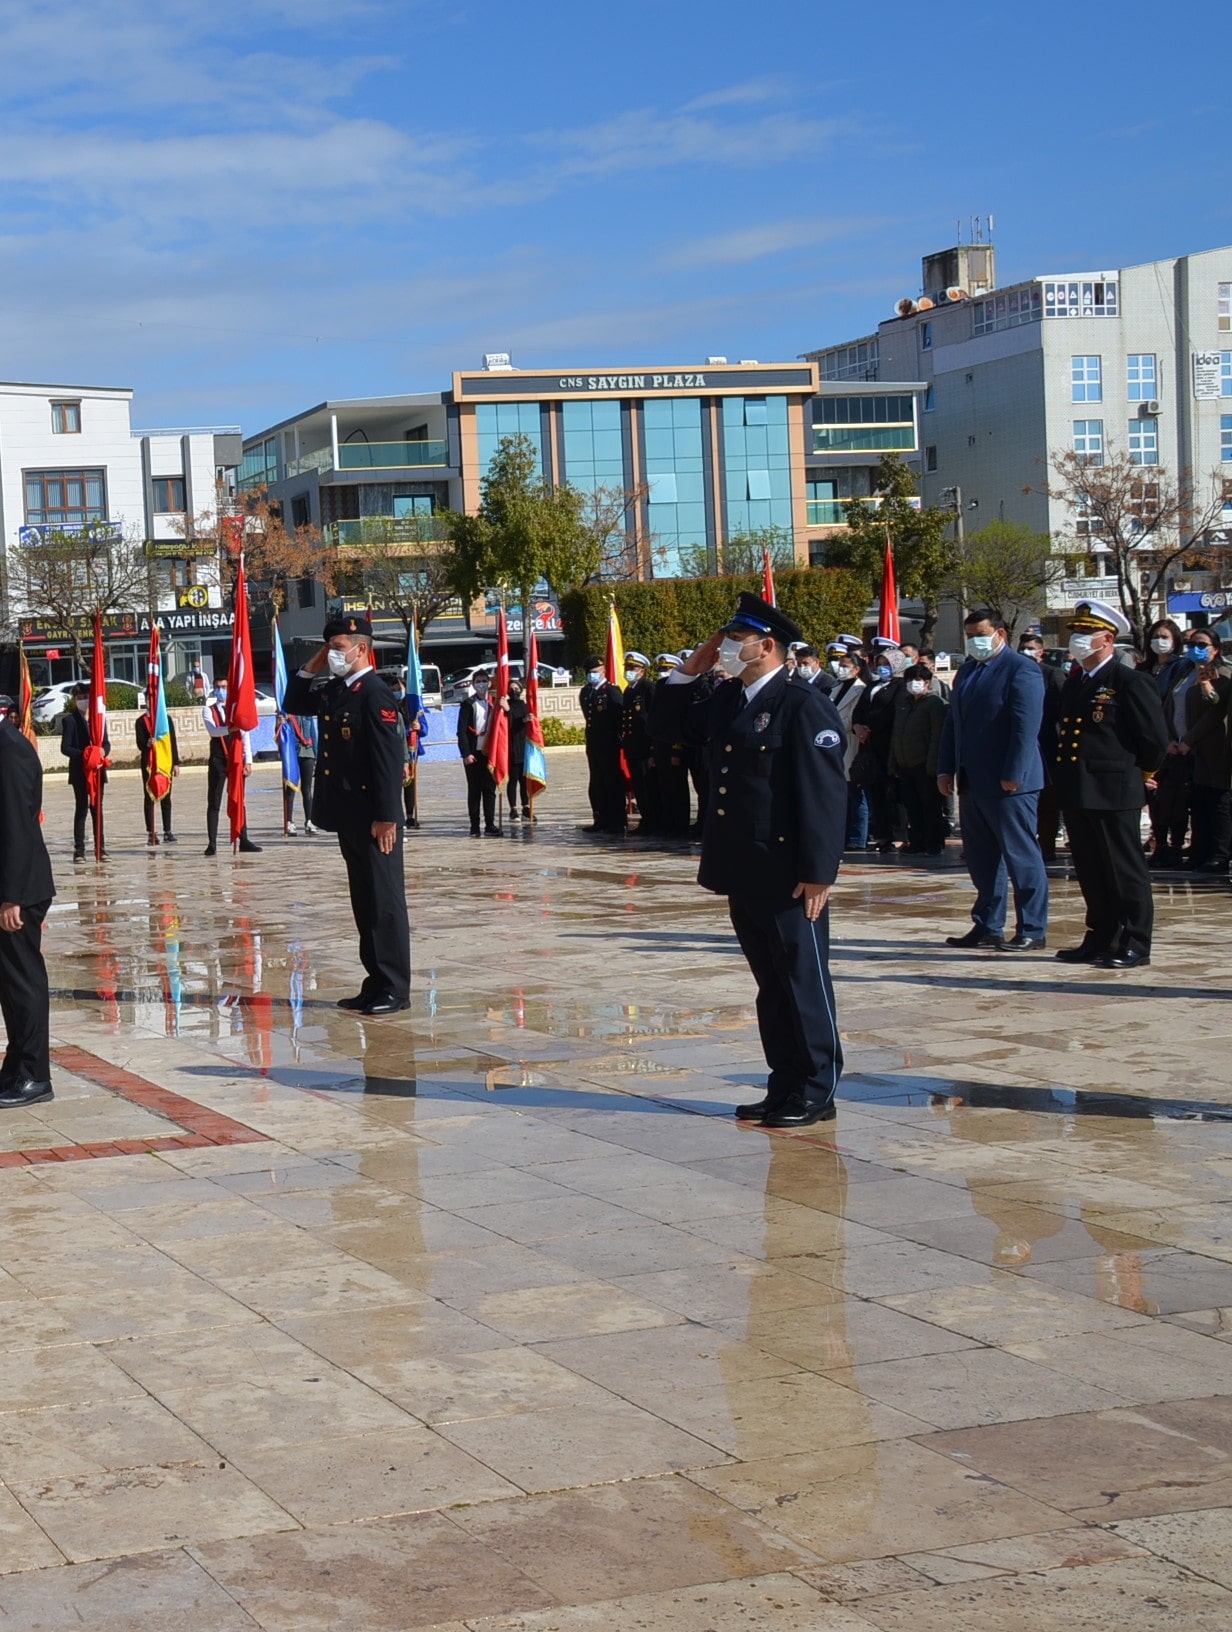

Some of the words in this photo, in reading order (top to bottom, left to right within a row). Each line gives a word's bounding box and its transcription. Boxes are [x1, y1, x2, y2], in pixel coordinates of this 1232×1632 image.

[1196, 353, 1220, 365] idea
[559, 377, 583, 388] CNS
[588, 375, 645, 390] SAYGIN
[652, 374, 706, 388] PLAZA
[168, 615, 196, 629] YAPI
[199, 611, 235, 629] İNŞAA
